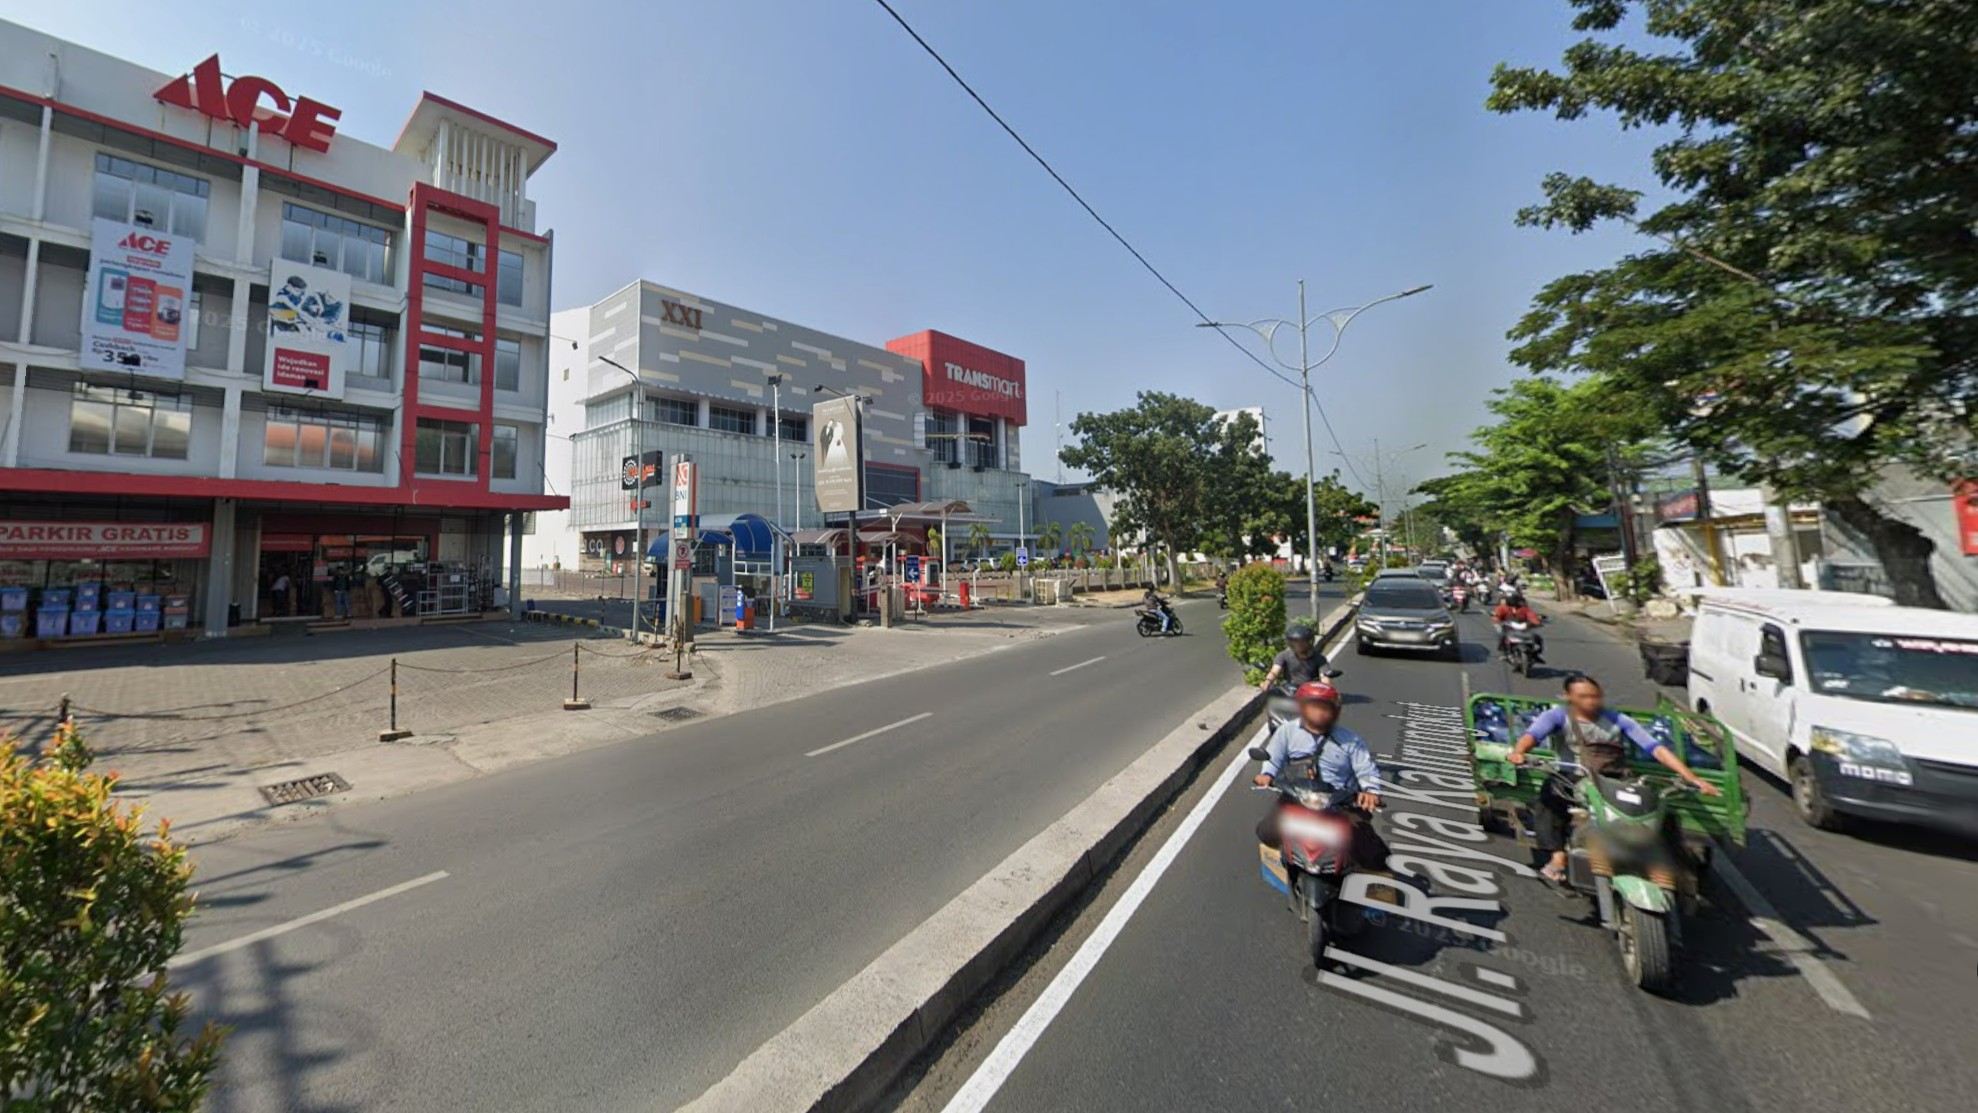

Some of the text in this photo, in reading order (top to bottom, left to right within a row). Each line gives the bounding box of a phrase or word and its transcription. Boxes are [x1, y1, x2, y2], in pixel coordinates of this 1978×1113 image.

[153, 52, 343, 154] ACE
[117, 231, 171, 256] ACE
[661, 299, 703, 330] XXI
[944, 362, 1021, 398] TRANSmart
[674, 489, 687, 501] BNI
[100, 526, 191, 541] GRATIS
[1839, 762, 1914, 786] momo
